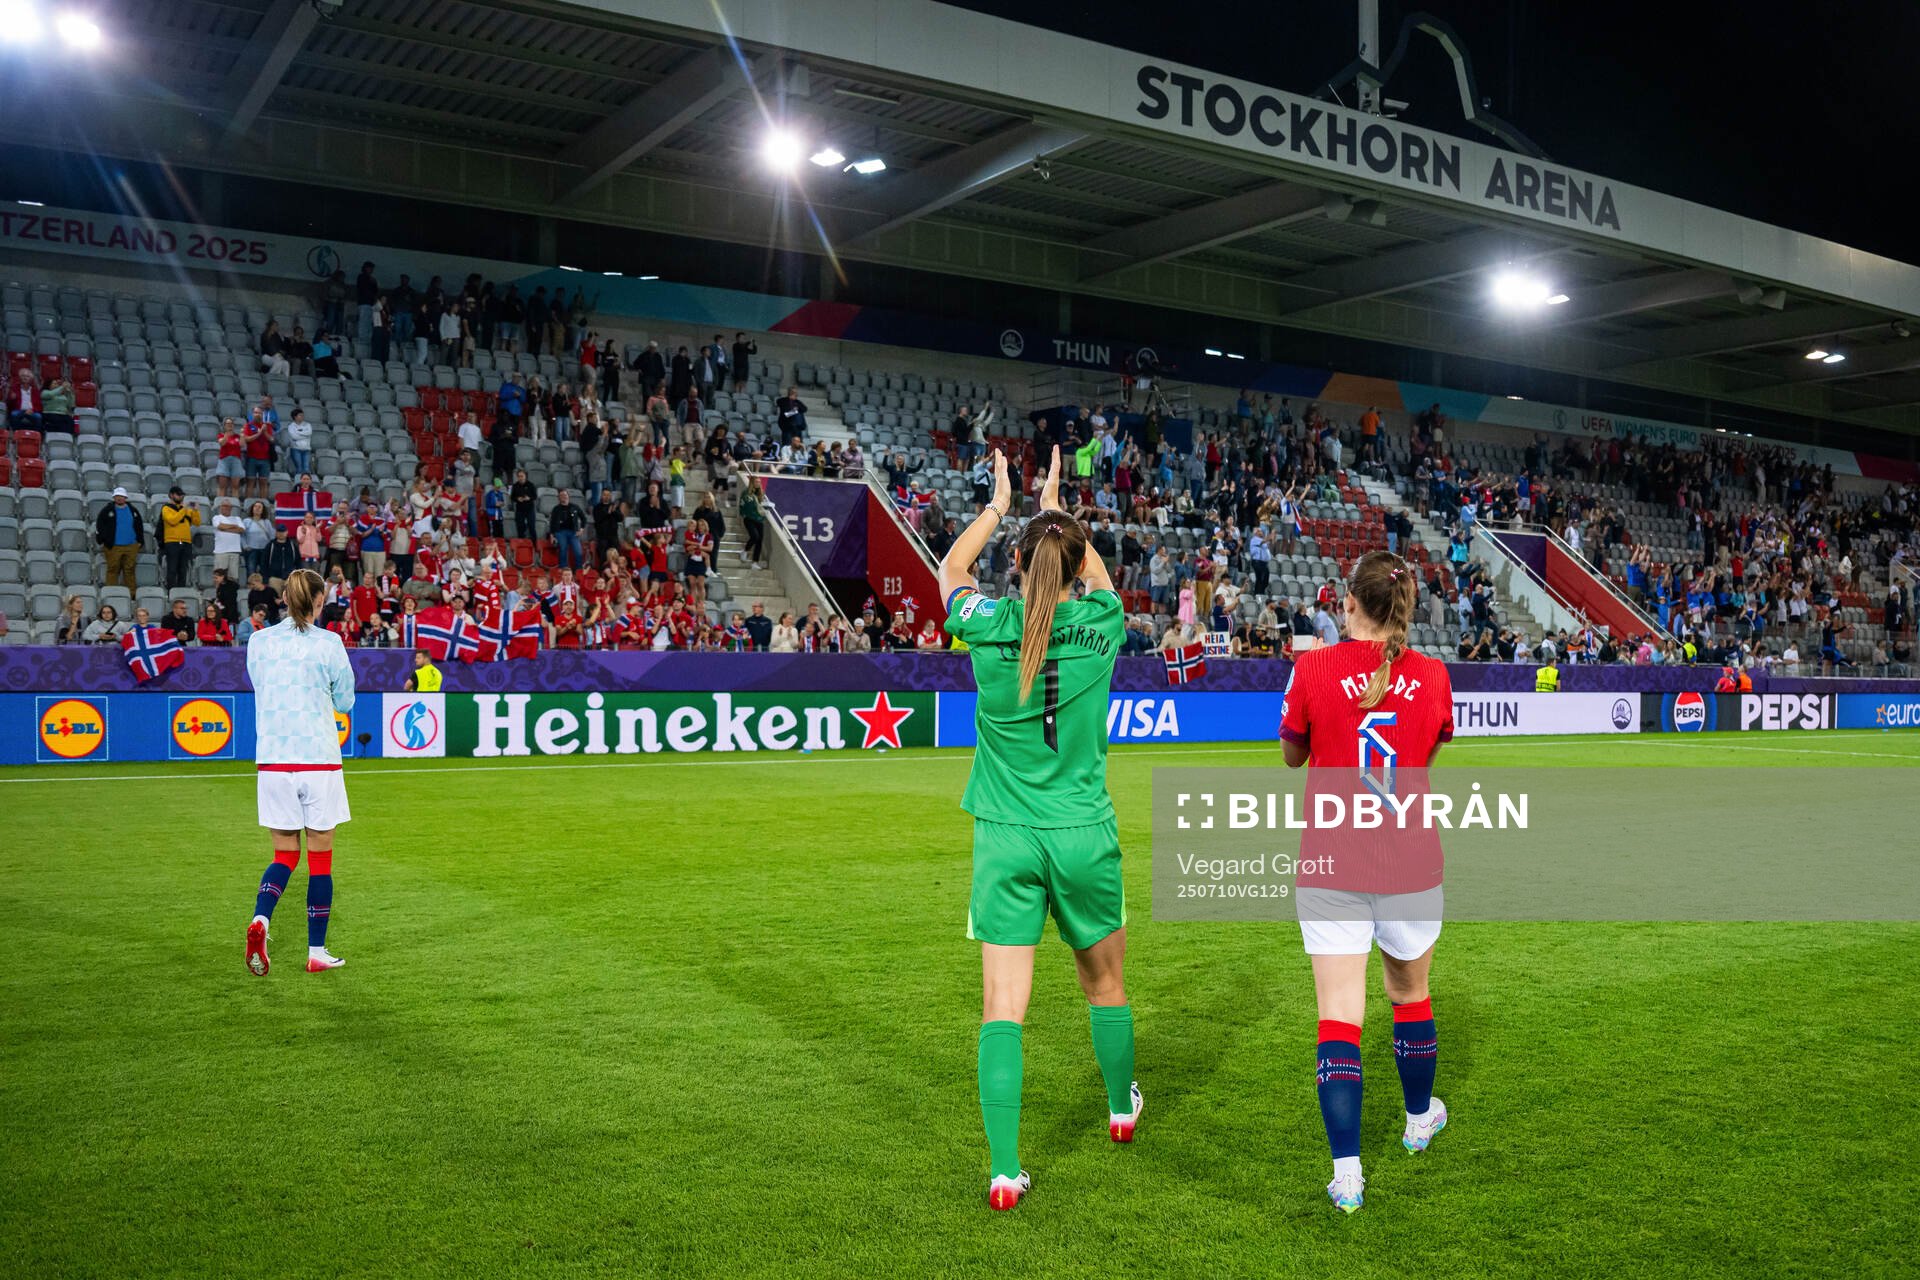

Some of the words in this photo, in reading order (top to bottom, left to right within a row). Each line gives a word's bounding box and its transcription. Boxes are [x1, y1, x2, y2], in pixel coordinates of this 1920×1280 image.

[1137, 65, 1460, 193] STOCKHORN
[1484, 156, 1621, 231] ARENA
[188, 233, 268, 265] 2025
[1052, 339, 1111, 365] THUN
[1581, 415, 1613, 433] UEFA
[1614, 419, 1667, 441] WOMEN'S
[1669, 428, 1697, 445] EURO
[782, 514, 835, 543] E13
[883, 576, 903, 595] E13
[1203, 645, 1231, 655] USTINE
[1204, 634, 1225, 644] HEIA
[1340, 671, 1421, 701] MJDE
[1038, 659, 1058, 754] 1
[1454, 702, 1518, 727] THUN
[1676, 707, 1703, 718] PEPSI
[1741, 693, 1829, 731] PEPSI
[1887, 703, 1920, 725] euro
[472, 692, 846, 757] Heineken
